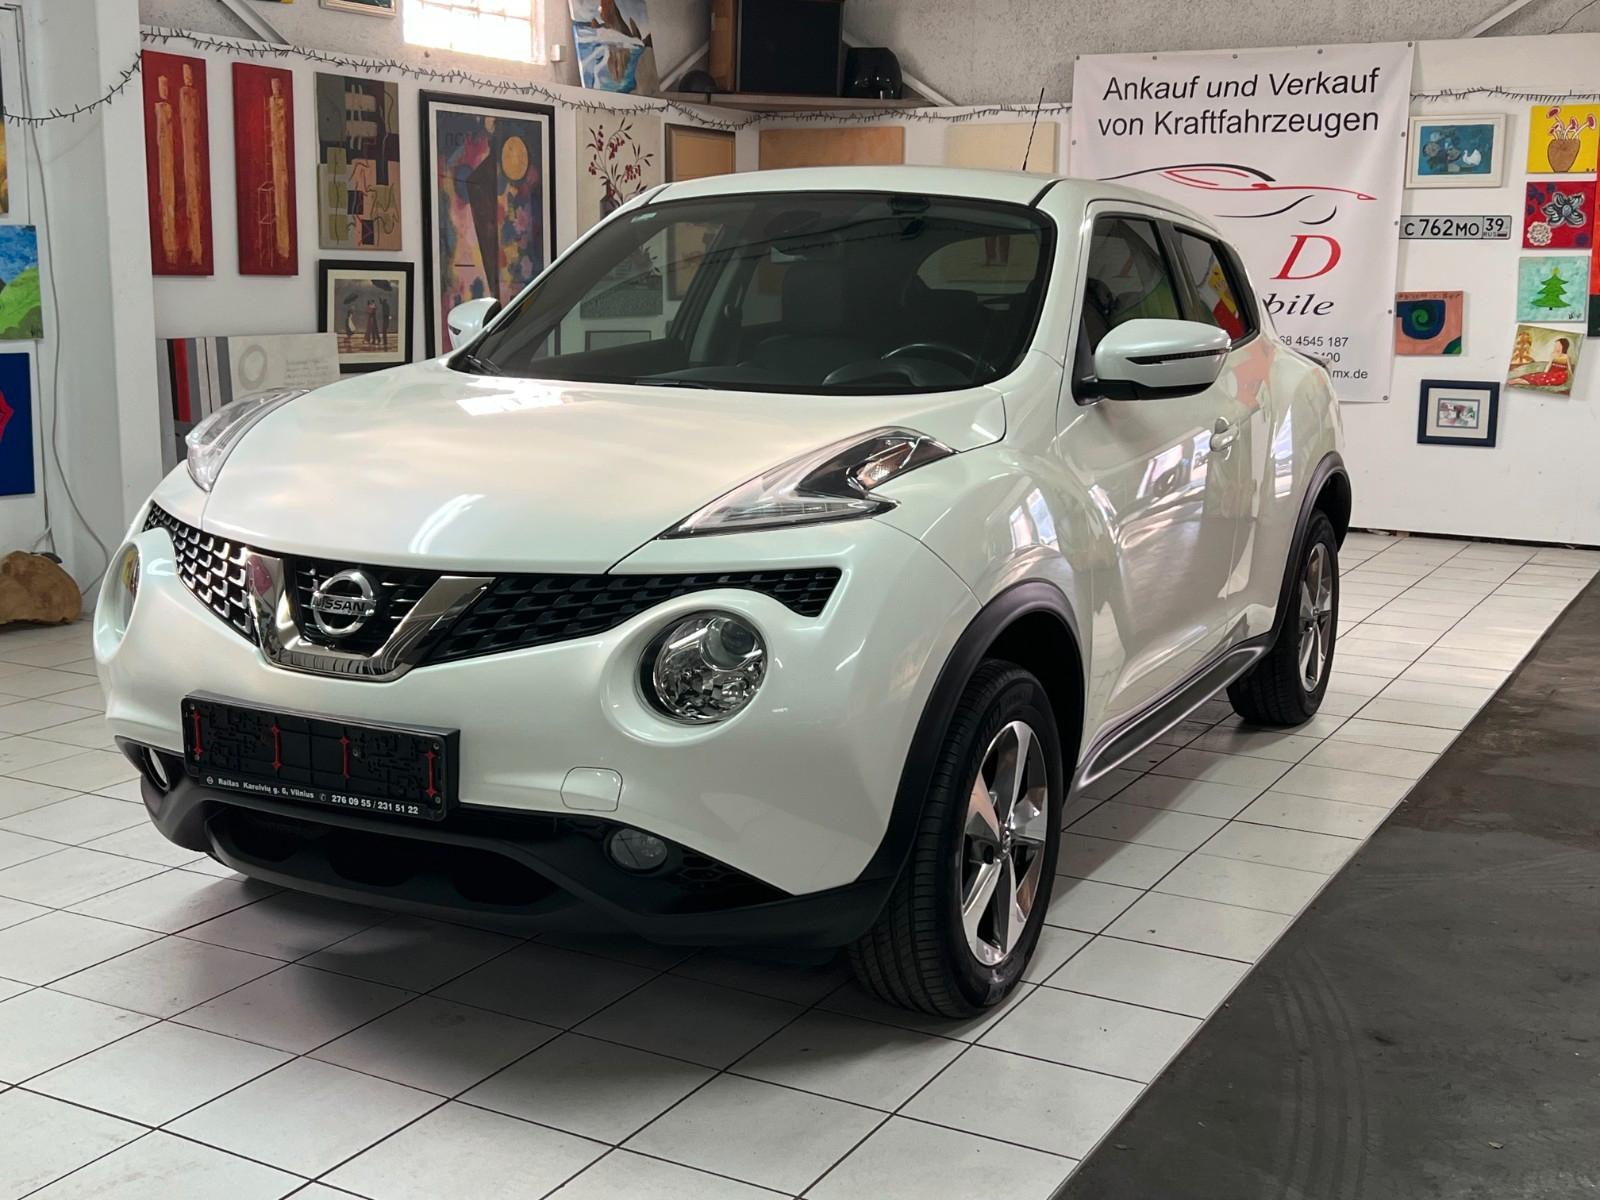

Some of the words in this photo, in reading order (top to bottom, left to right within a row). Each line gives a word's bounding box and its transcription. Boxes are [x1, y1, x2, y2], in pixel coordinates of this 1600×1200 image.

[1102, 75, 1200, 101] Ankauf
[1206, 74, 1258, 98] und
[1269, 67, 1381, 96] Verkauf
[1098, 117, 1144, 136] von
[1154, 109, 1379, 138] Kraftfahrzeugen
[1485, 217, 1504, 231] 39
[1269, 234, 1342, 280] D
[1295, 335, 1324, 347] 4545
[1328, 336, 1349, 348] 187
[314, 597, 365, 611] NISSAN
[290, 788, 314, 799] Vilnius
[331, 794, 347, 804] 276
[394, 804, 405, 813] 51
[407, 805, 419, 815] 22
